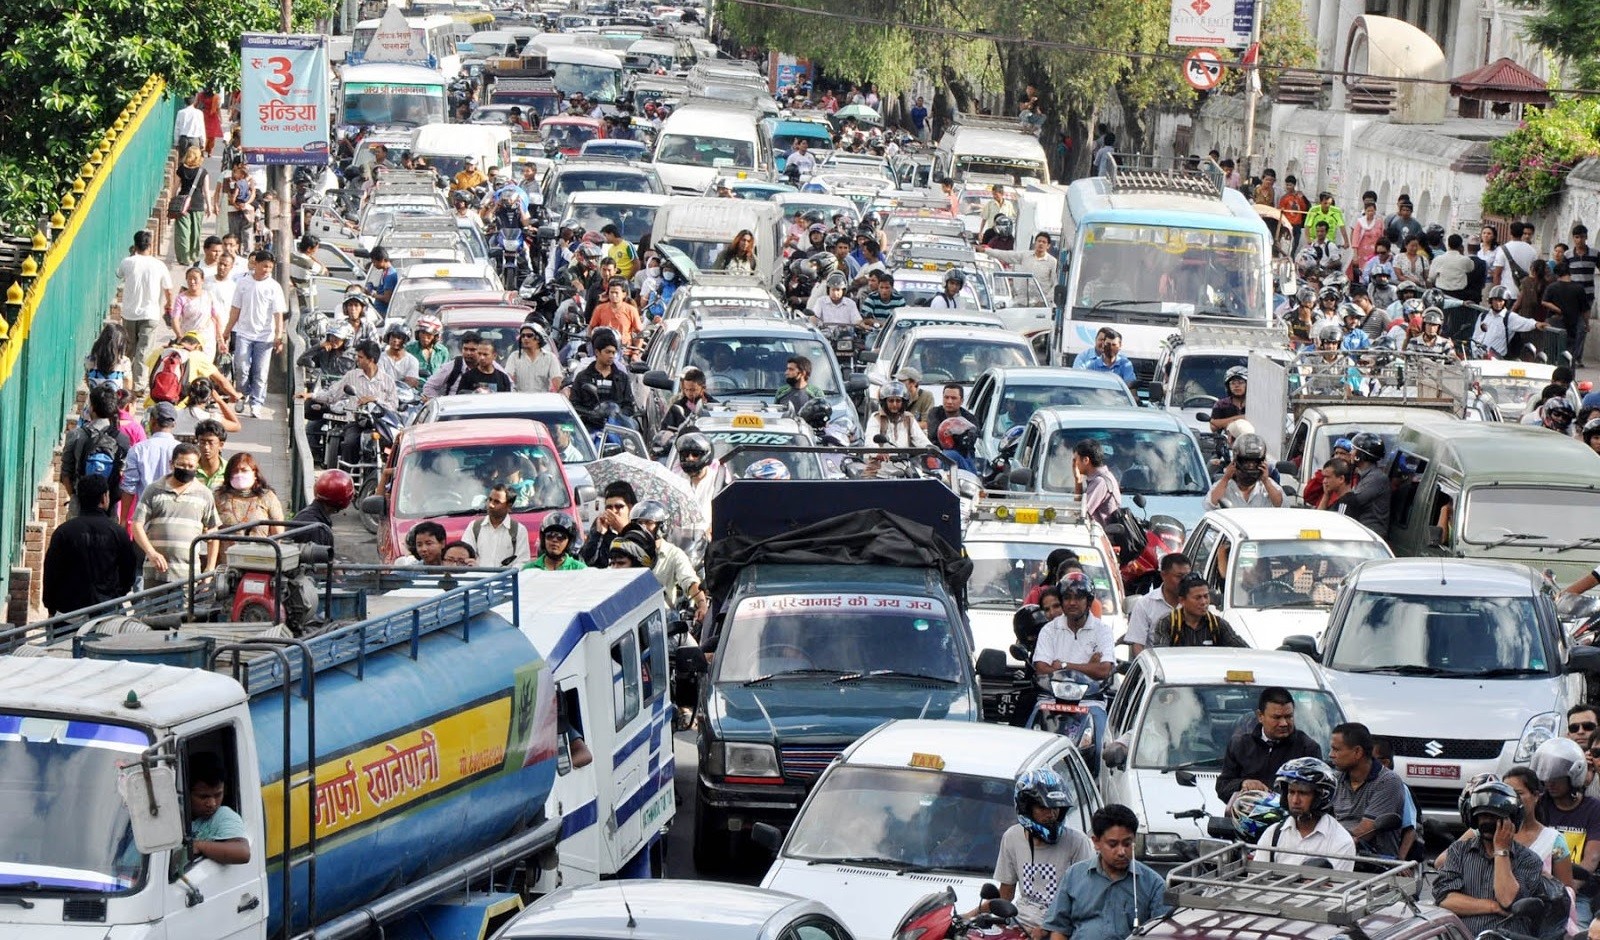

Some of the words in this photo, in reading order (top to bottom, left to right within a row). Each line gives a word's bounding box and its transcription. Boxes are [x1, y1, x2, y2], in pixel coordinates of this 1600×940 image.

[266, 56, 294, 96] ३
[258, 99, 317, 123] इन्डिया
[703, 299, 770, 308] SUZUKI
[737, 415, 759, 425] TAXI
[847, 596, 869, 608] की
[873, 599, 900, 608] जय
[905, 600, 932, 611] जय
[913, 753, 939, 768] TAXI
[362, 729, 440, 808] खानेपानी
